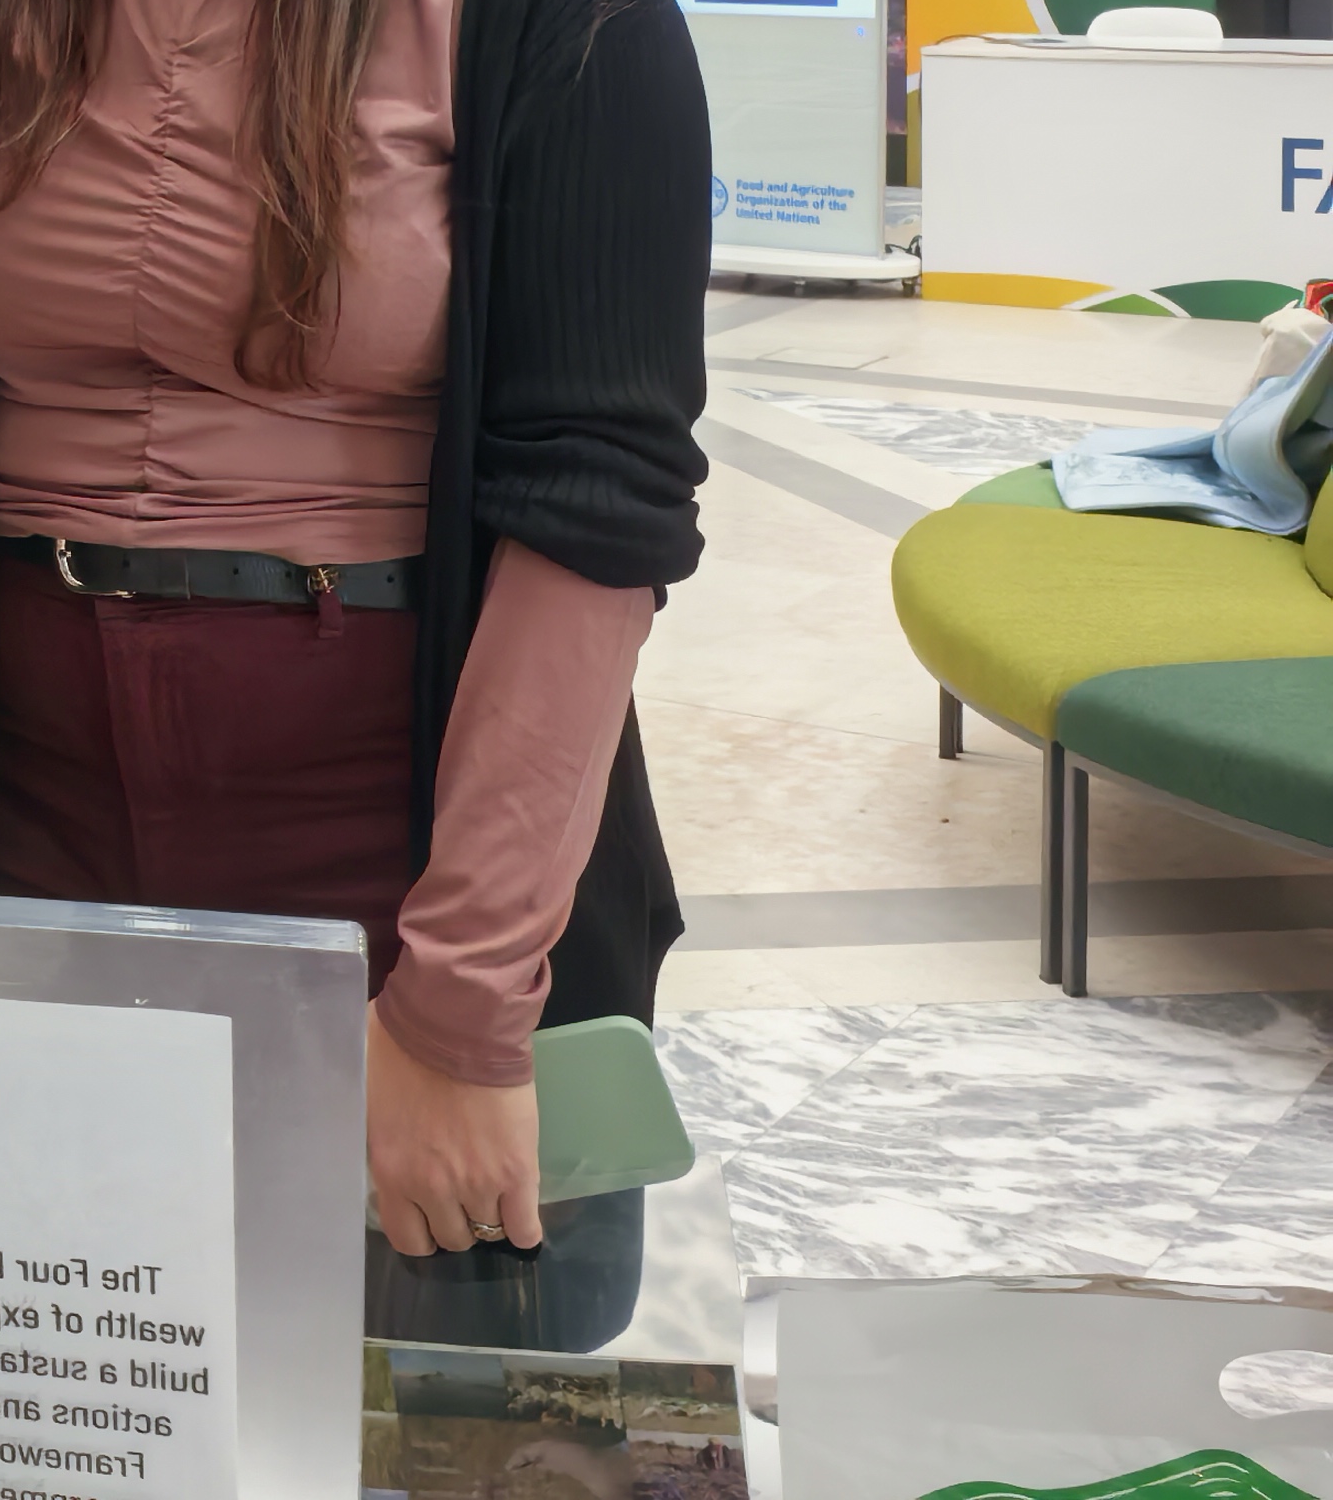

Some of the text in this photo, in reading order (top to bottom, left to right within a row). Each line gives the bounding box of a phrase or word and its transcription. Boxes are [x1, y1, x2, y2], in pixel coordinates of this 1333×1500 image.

[736, 179, 855, 198] Food and Agriculture
[736, 193, 847, 211] Organization of the
[735, 207, 821, 225] United Nations
